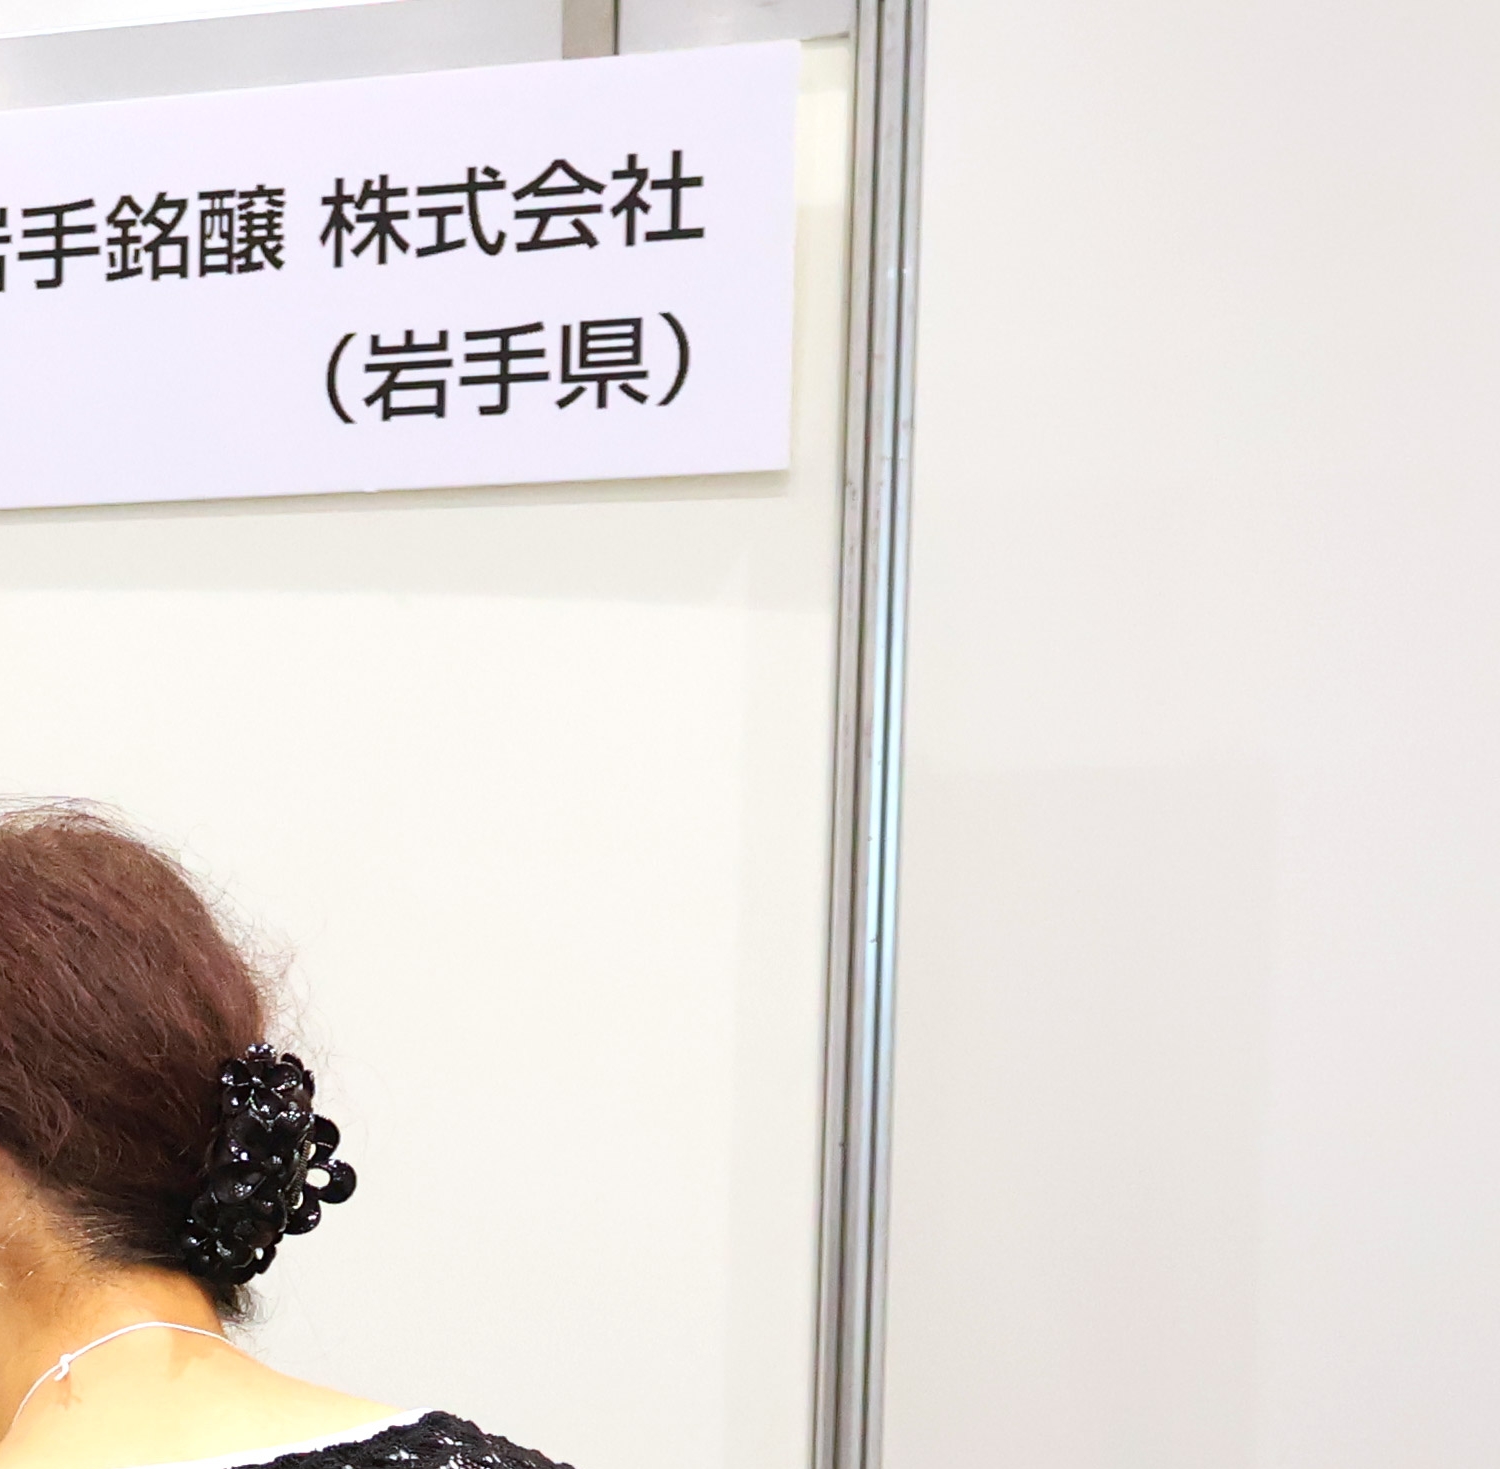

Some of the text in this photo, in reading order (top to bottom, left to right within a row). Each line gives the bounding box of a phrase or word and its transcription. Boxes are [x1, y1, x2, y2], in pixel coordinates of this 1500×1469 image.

[319, 150, 705, 268] 株式会社
[326, 311, 691, 425] （岩手県）
